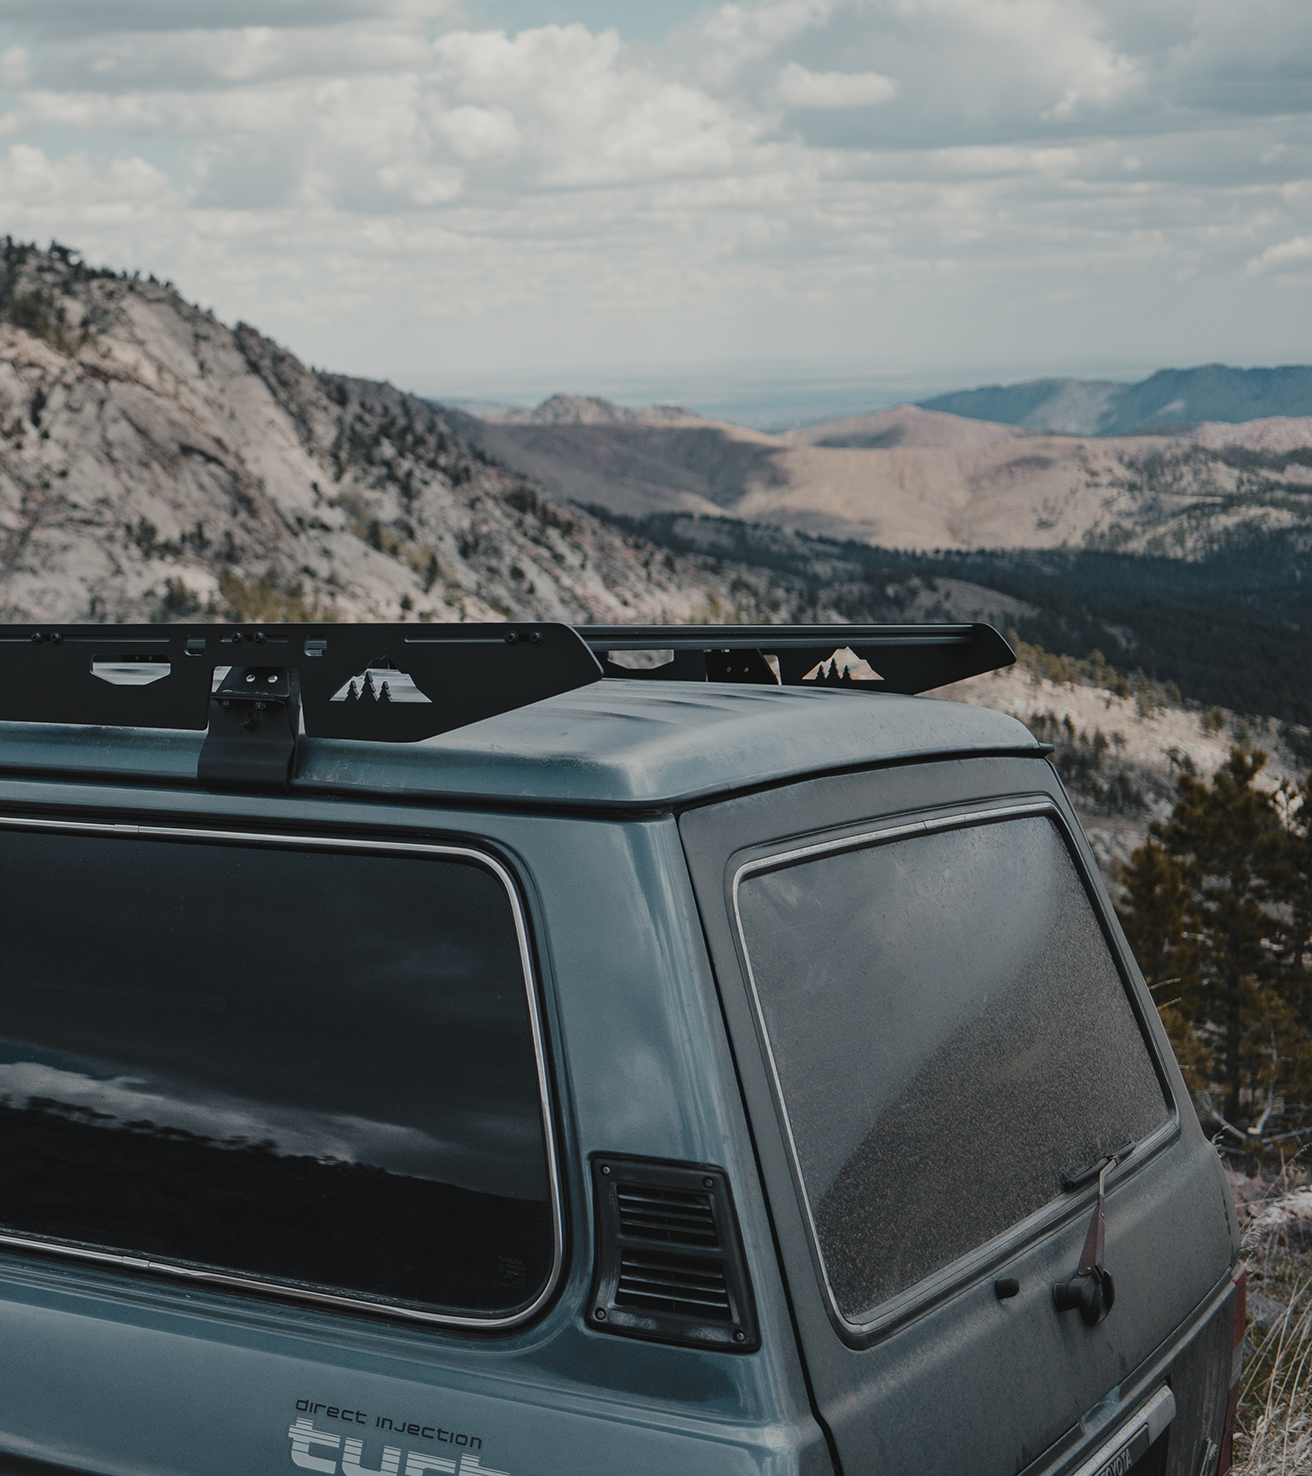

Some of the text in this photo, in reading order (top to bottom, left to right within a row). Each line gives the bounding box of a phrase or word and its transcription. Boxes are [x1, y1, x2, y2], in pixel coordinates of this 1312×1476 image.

[295, 1399, 482, 1449] direct injection
[1100, 1448, 1133, 1476] YOTA
